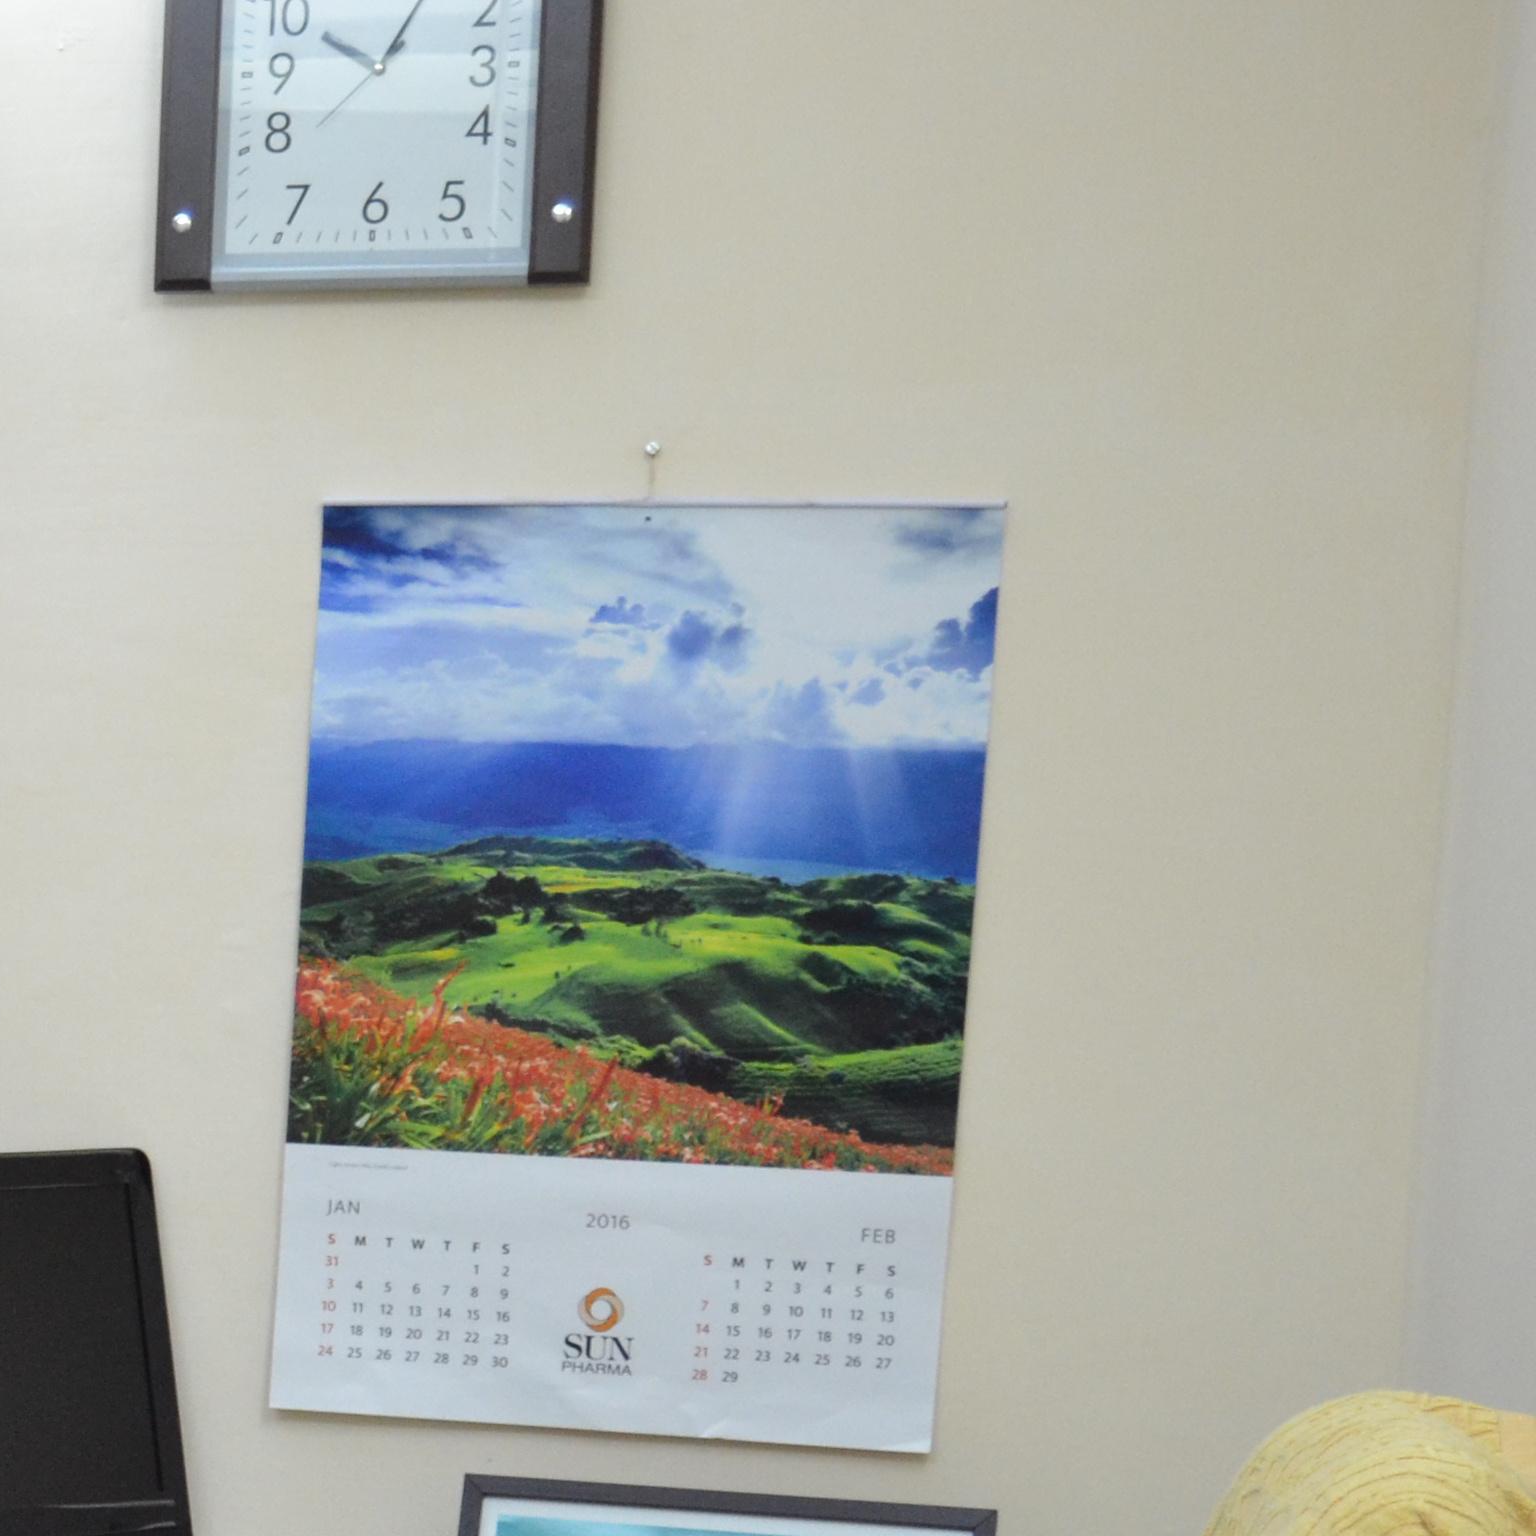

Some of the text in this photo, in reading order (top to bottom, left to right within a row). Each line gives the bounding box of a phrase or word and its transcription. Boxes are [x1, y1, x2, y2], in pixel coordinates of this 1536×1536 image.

[268, 0, 310, 37] 10
[268, 51, 295, 96] 9
[469, 44, 497, 88] 3
[264, 111, 292, 153] 8
[465, 104, 493, 146] 4
[285, 184, 311, 226] 7
[361, 181, 389, 224] 6
[438, 180, 466, 222] 5
[326, 1199, 361, 1217] JAN
[585, 1212, 631, 1231] 2016
[327, 1233, 511, 1256] S M T W T F S
[860, 1227, 896, 1245] FEB
[326, 1255, 511, 1278] 31 1 2
[703, 1254, 897, 1278] S M T W T F S
[327, 1277, 510, 1301] 3 4 5 6 7 8 9
[734, 1278, 895, 1300] 1 2 3 4 5 6
[322, 1300, 511, 1323] 10 11 12 13 14 15 16
[701, 1300, 895, 1324] 7 8 9 10 11 12 13
[321, 1322, 510, 1346] 17 18 19 20 21 22 23
[696, 1323, 896, 1347] 14 15 16 17 18 19 20
[317, 1345, 509, 1369] 24 25 26 27 28 29 30
[563, 1332, 634, 1361] SUN
[693, 1345, 893, 1370] 21 22 23 24 25 26 27
[561, 1360, 632, 1377] PHARMA
[691, 1368, 739, 1384] 28 29
